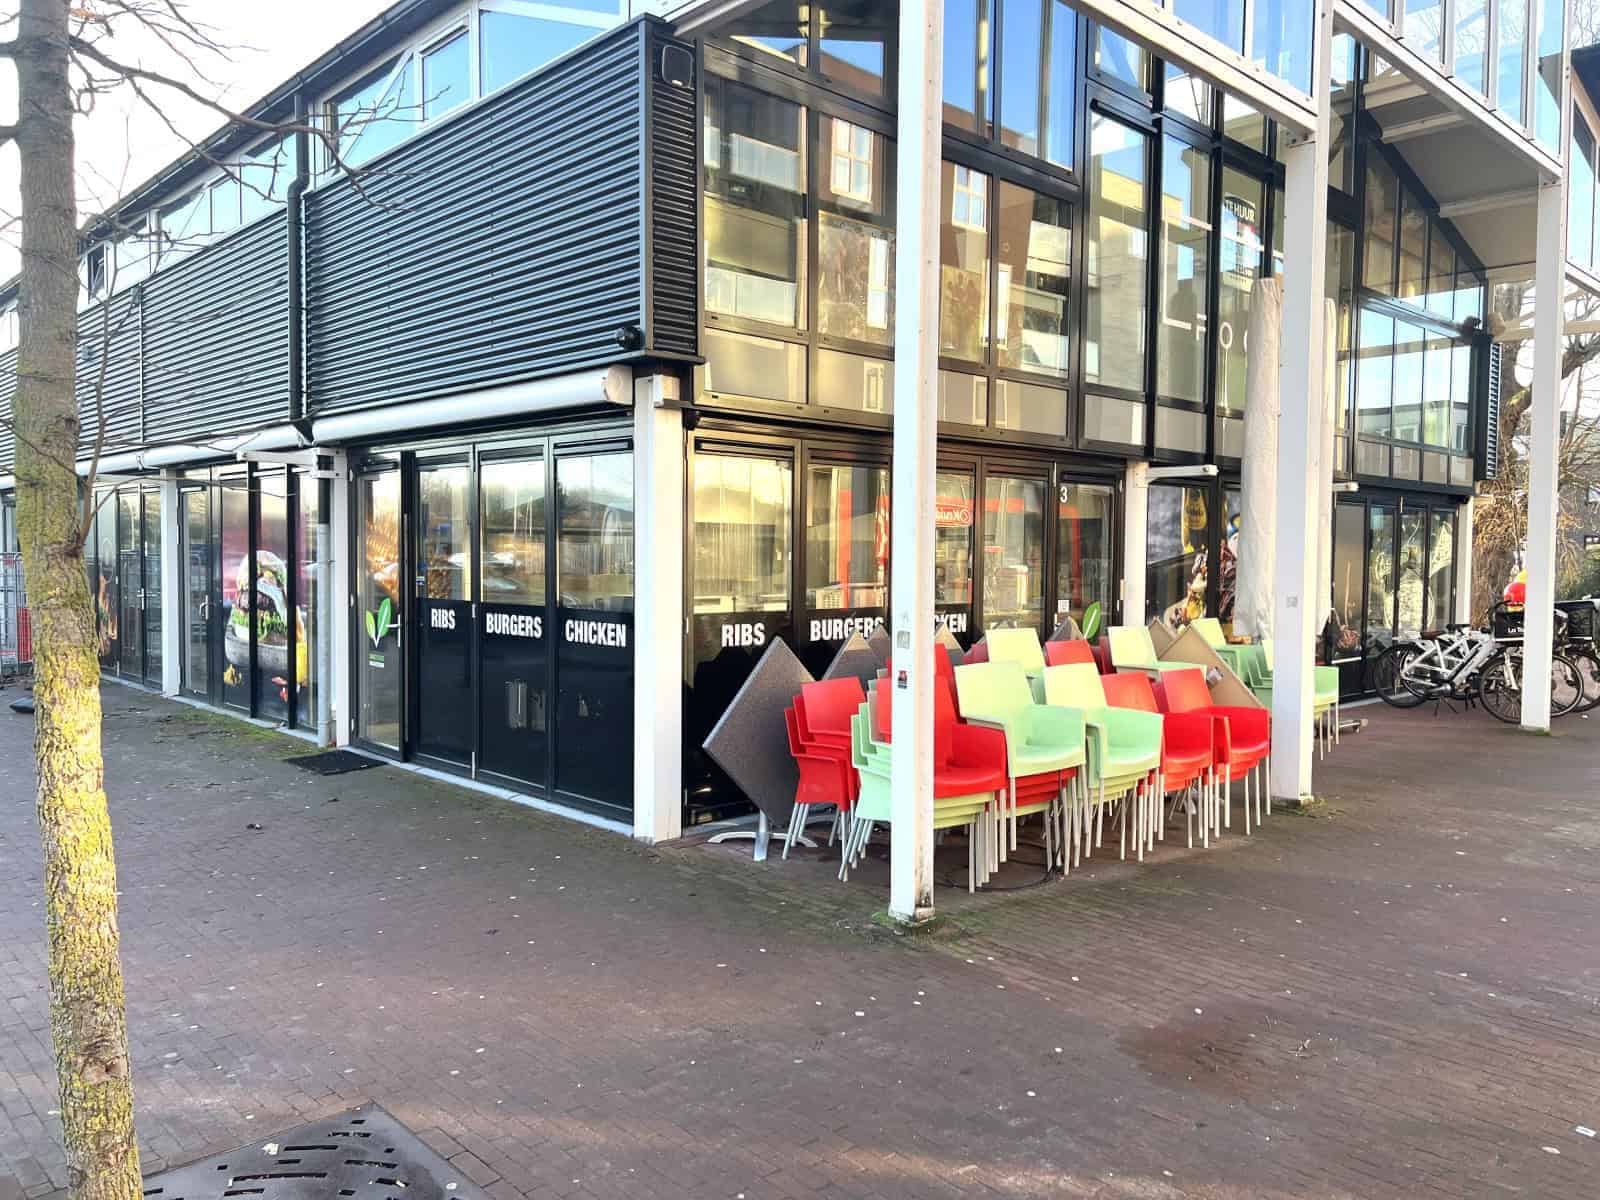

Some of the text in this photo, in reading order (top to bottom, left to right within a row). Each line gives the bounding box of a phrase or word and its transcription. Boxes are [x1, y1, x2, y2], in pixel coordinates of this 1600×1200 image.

[1234, 203, 1255, 222] HUUR
[1060, 486, 1068, 503] 3
[431, 608, 456, 629] RIBS
[486, 612, 542, 638] BURGERS
[565, 619, 627, 647] CHICKEN
[721, 622, 766, 647] RIBS
